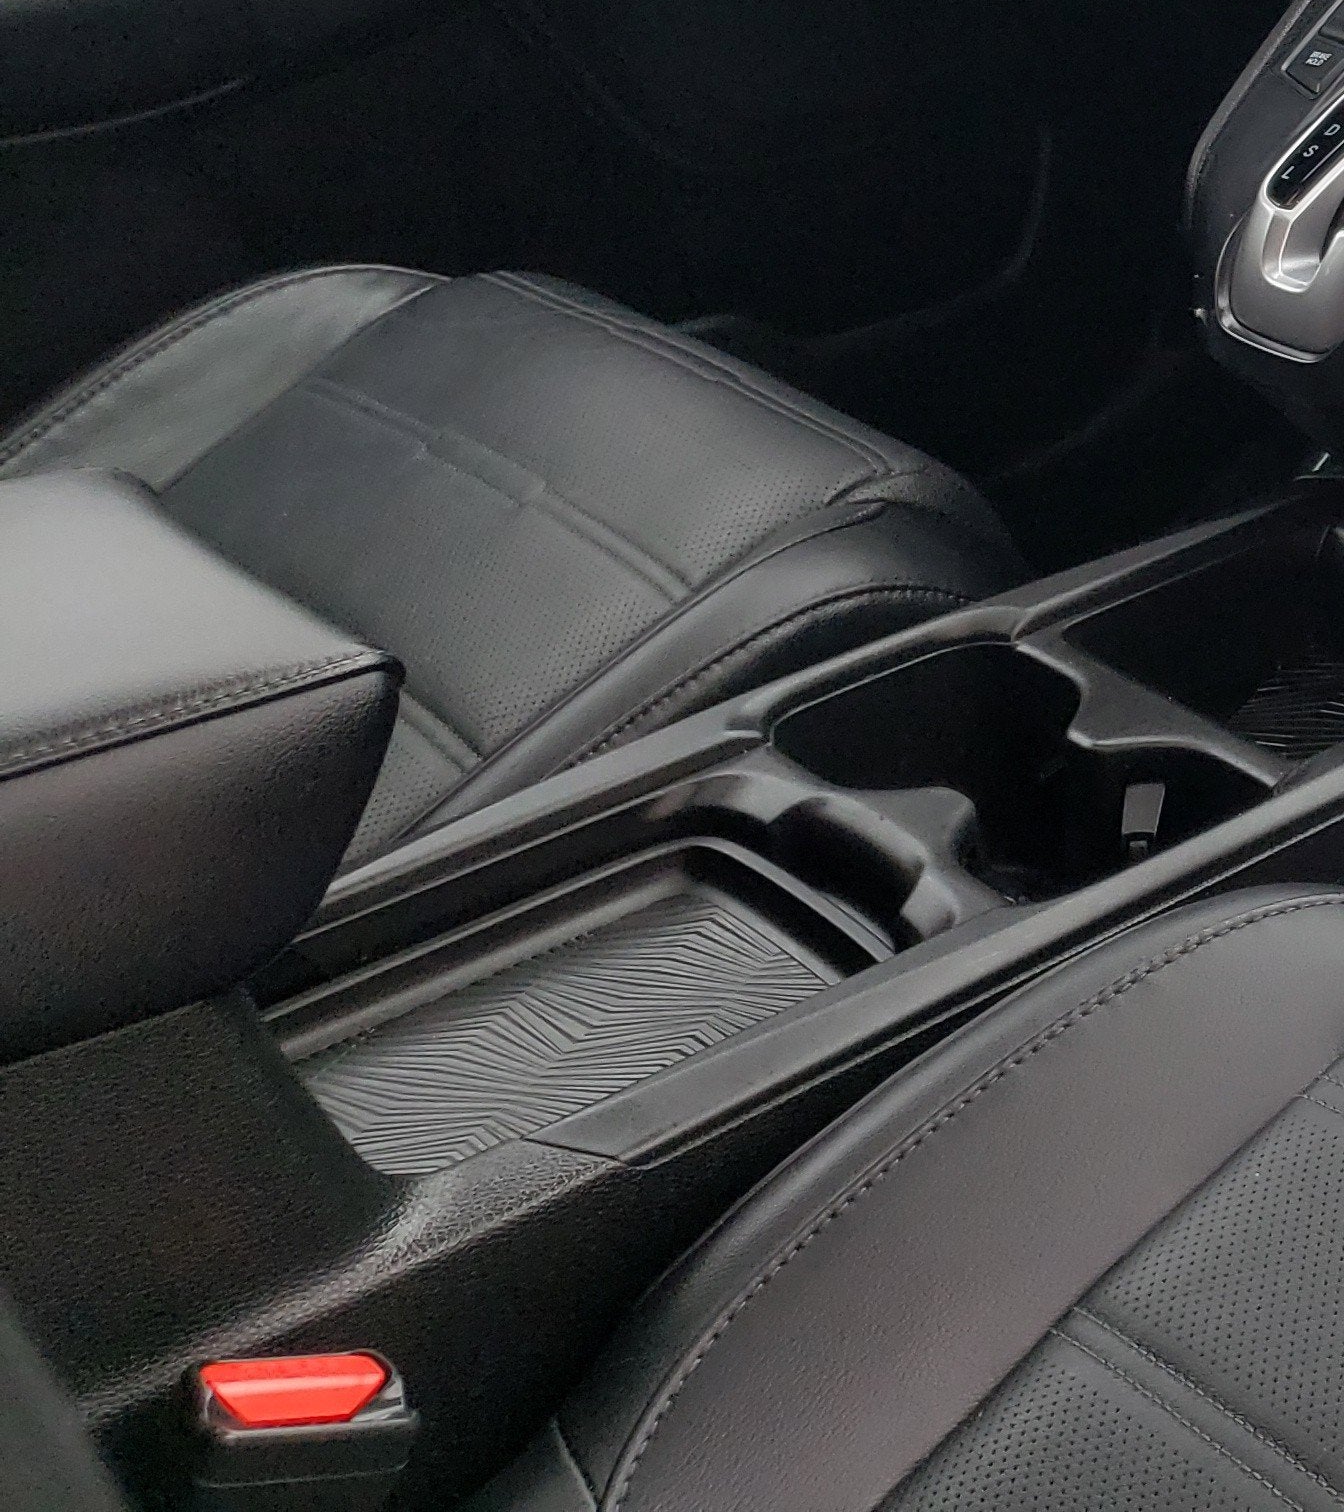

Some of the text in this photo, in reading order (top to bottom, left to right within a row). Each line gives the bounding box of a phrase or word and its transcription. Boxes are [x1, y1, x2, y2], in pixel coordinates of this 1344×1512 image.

[1323, 123, 1341, 136] D
[1302, 144, 1319, 158] S
[1280, 165, 1295, 180] L
